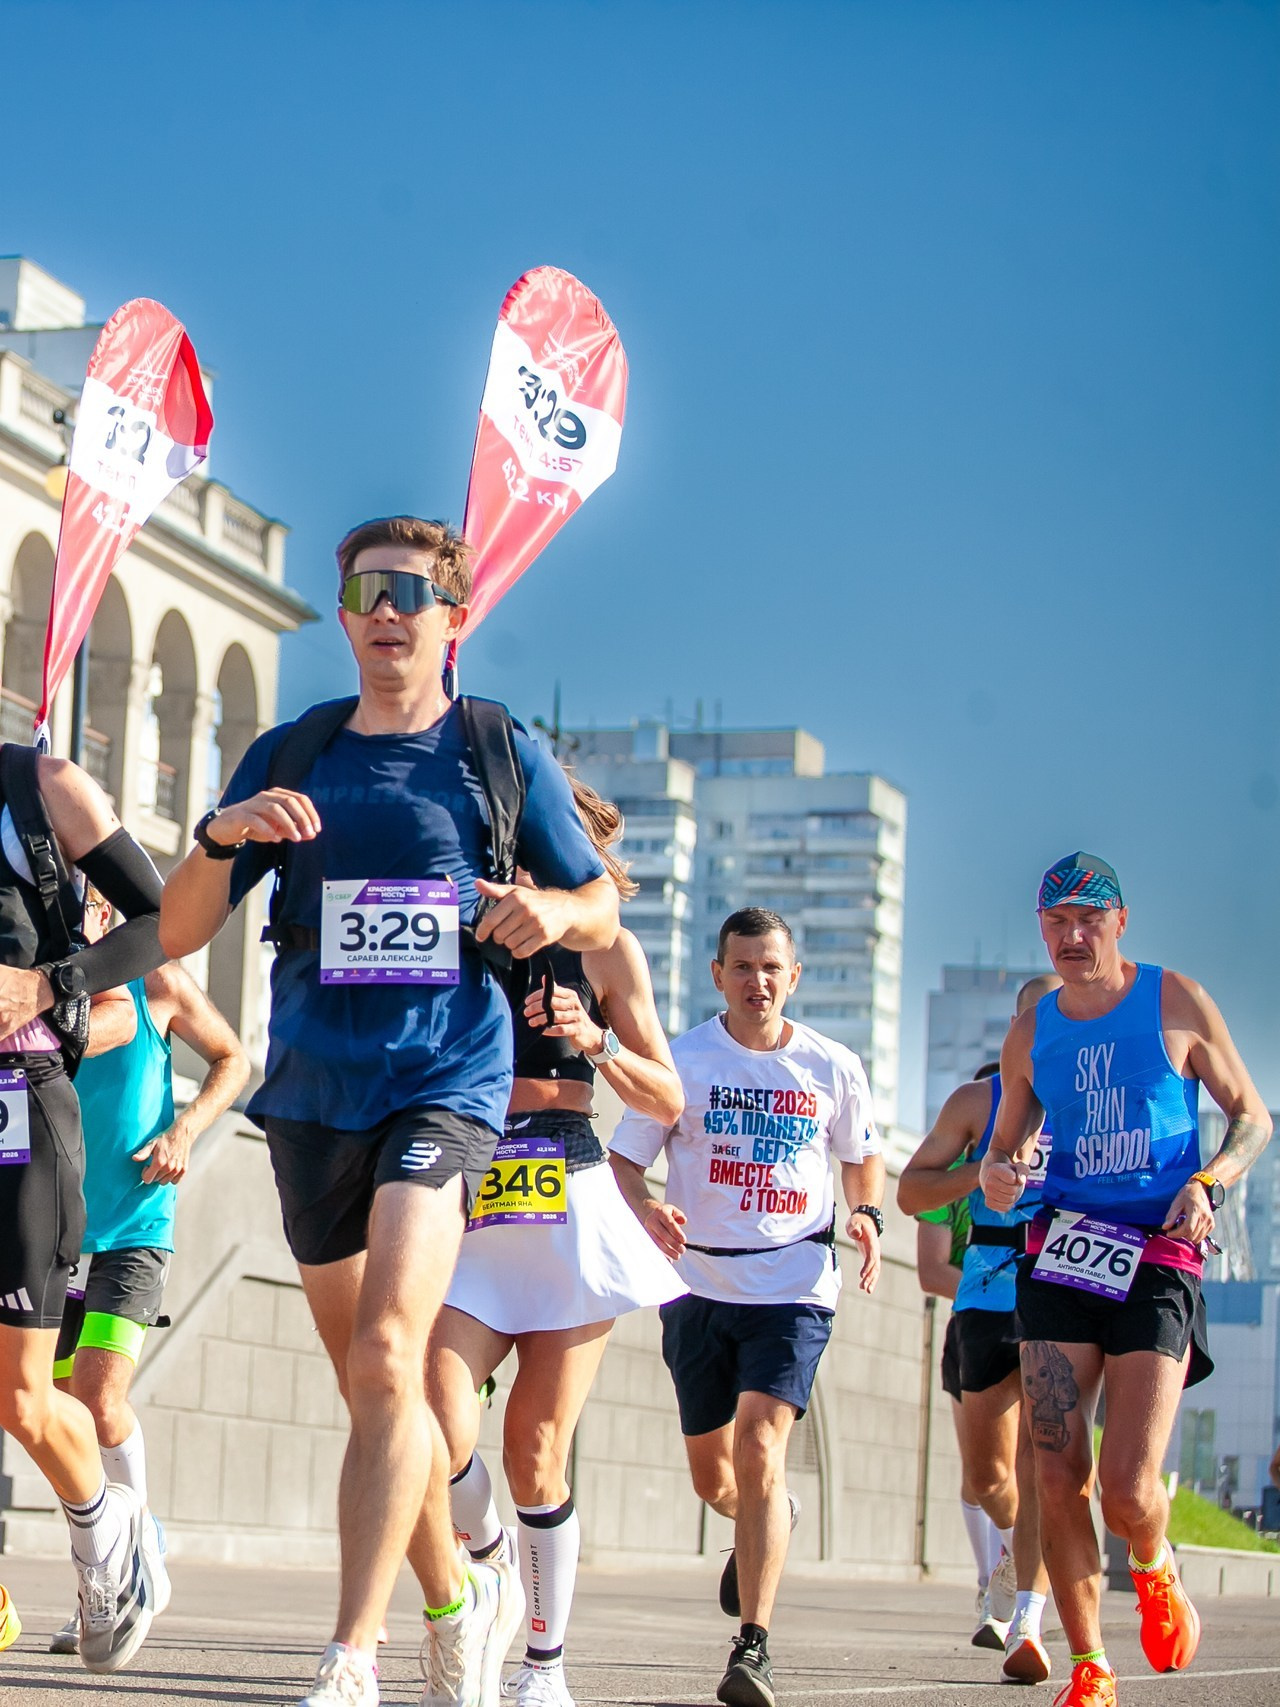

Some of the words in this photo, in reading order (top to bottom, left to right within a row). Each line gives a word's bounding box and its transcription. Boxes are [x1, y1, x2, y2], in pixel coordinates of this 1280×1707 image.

[340, 911, 440, 952] 3:29
[380, 955, 433, 963] АЛЕКСАНДР
[1075, 1042, 1115, 1092] SKY
[1085, 1086, 1125, 1134] RUN
[709, 1158, 775, 1188] ВМЕСТЕ
[1075, 1128, 1151, 1179] SCHOOL
[476, 1164, 561, 1201] 346
[1098, 1175, 1115, 1185] FEEL
[740, 1188, 753, 1212] С
[757, 1188, 808, 1215] ТОБОЙ
[1045, 1233, 1135, 1277] 4076
[1057, 1263, 1084, 1274] АНТИПОВ
[1084, 1269, 1106, 1280] ПАВЕЛ
[530, 1544, 541, 1616] COMPRESSPORT
